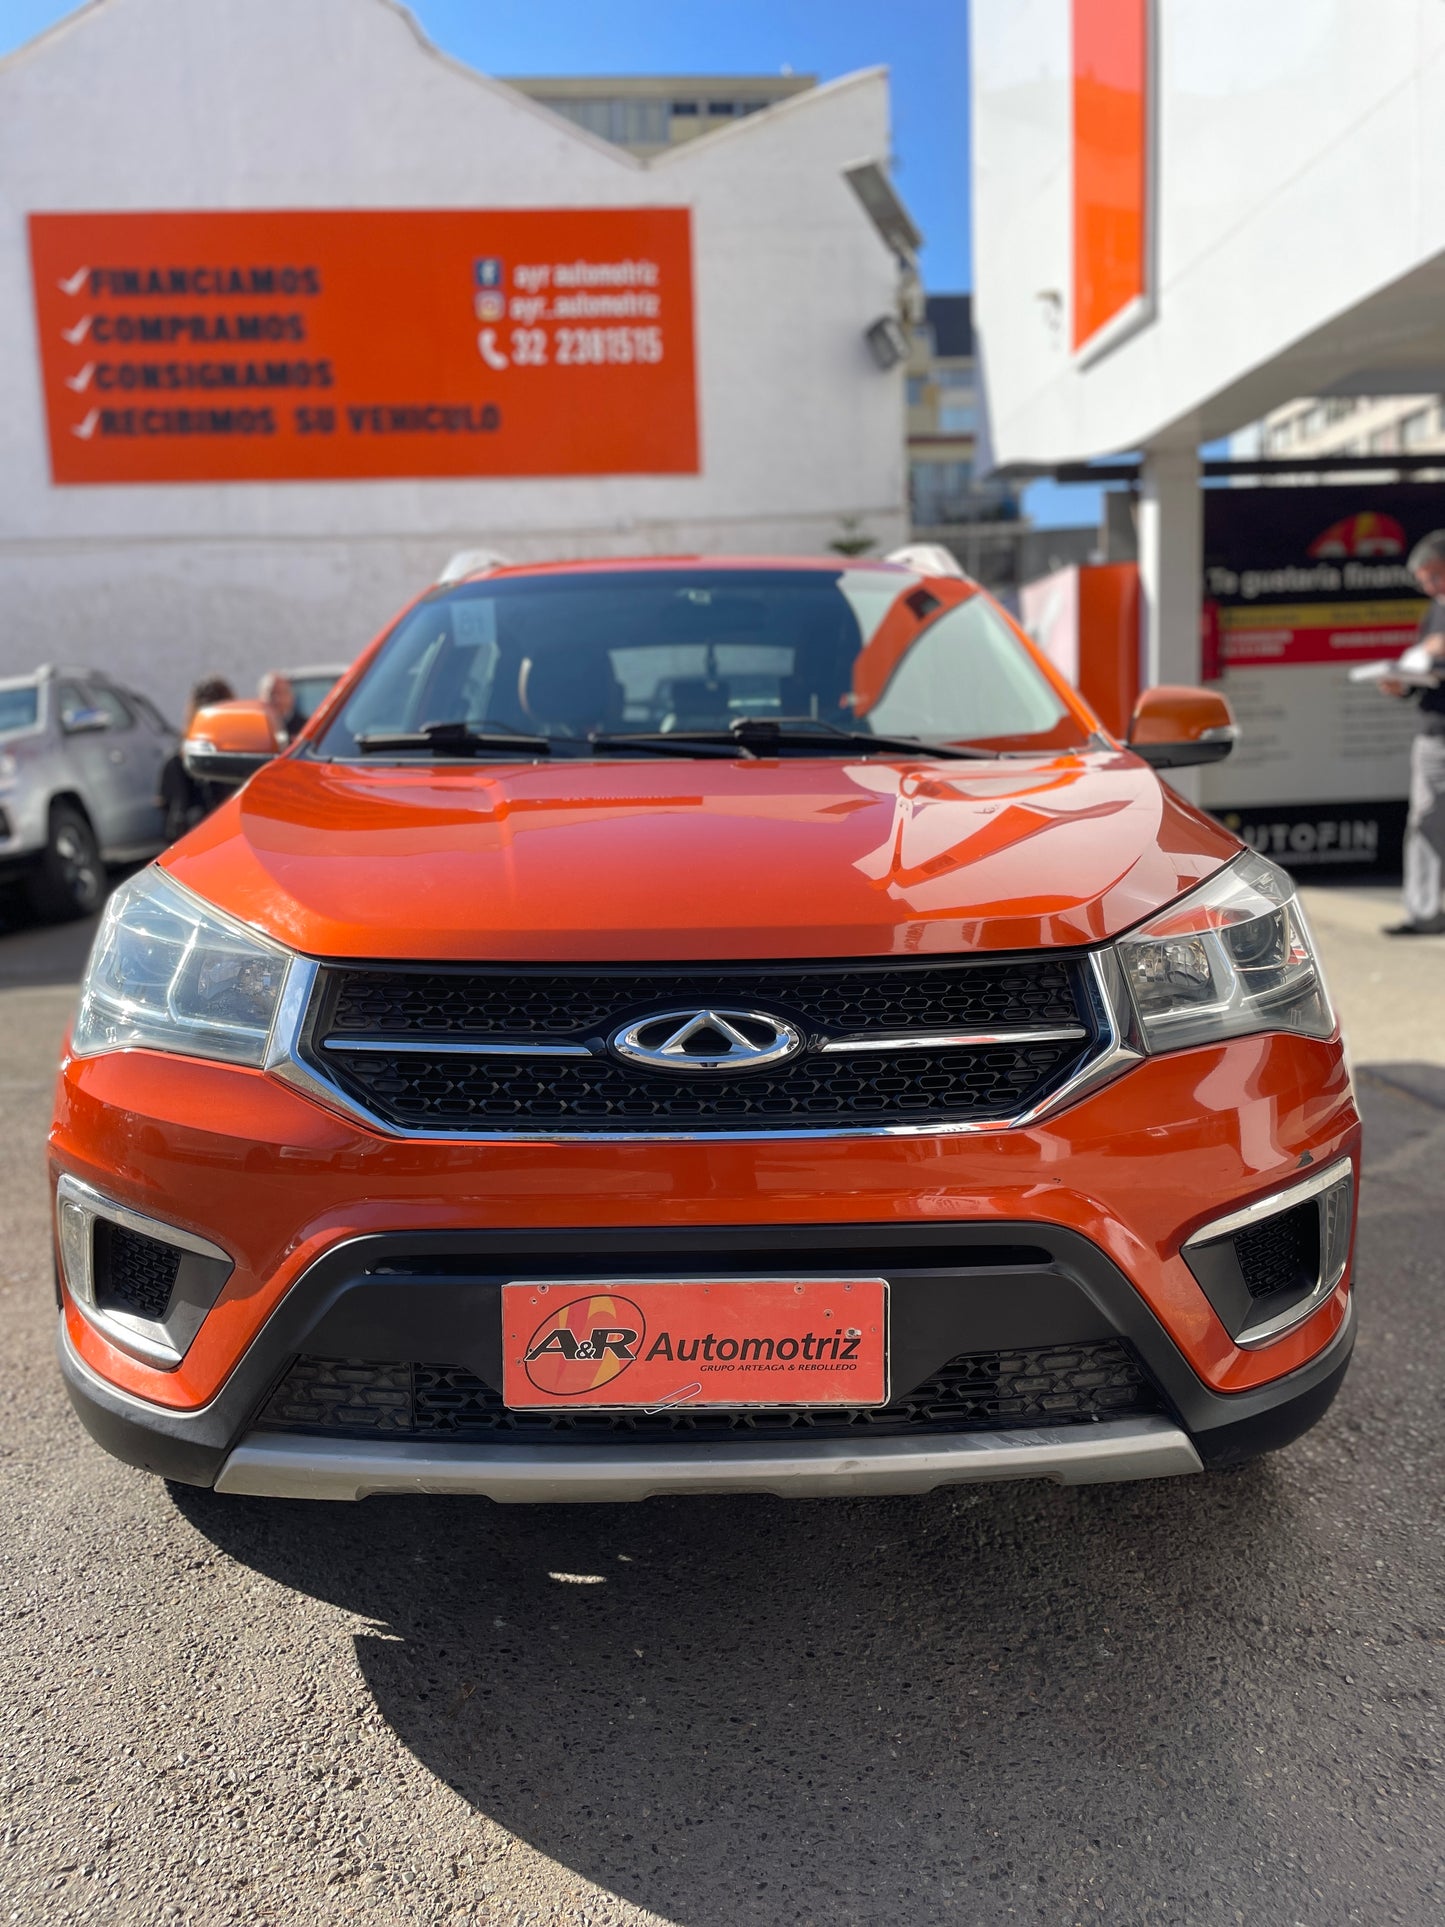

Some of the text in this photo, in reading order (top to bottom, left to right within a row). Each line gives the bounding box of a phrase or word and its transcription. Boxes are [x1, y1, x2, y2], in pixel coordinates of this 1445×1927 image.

[89, 266, 321, 297] FINANCIAMOS
[553, 259, 660, 288] automotriz
[92, 314, 304, 343] COMPRAMOS
[95, 360, 334, 390] CONSIGNAMOS
[101, 404, 501, 436] RECIBIMOS SU VEHICULO
[1243, 820, 1379, 852] UTOFIN
[524, 1328, 861, 1362] A&R Automotriz
[700, 1364, 735, 1372] GRUPO
[798, 1363, 857, 1371] REBOLLEDO
